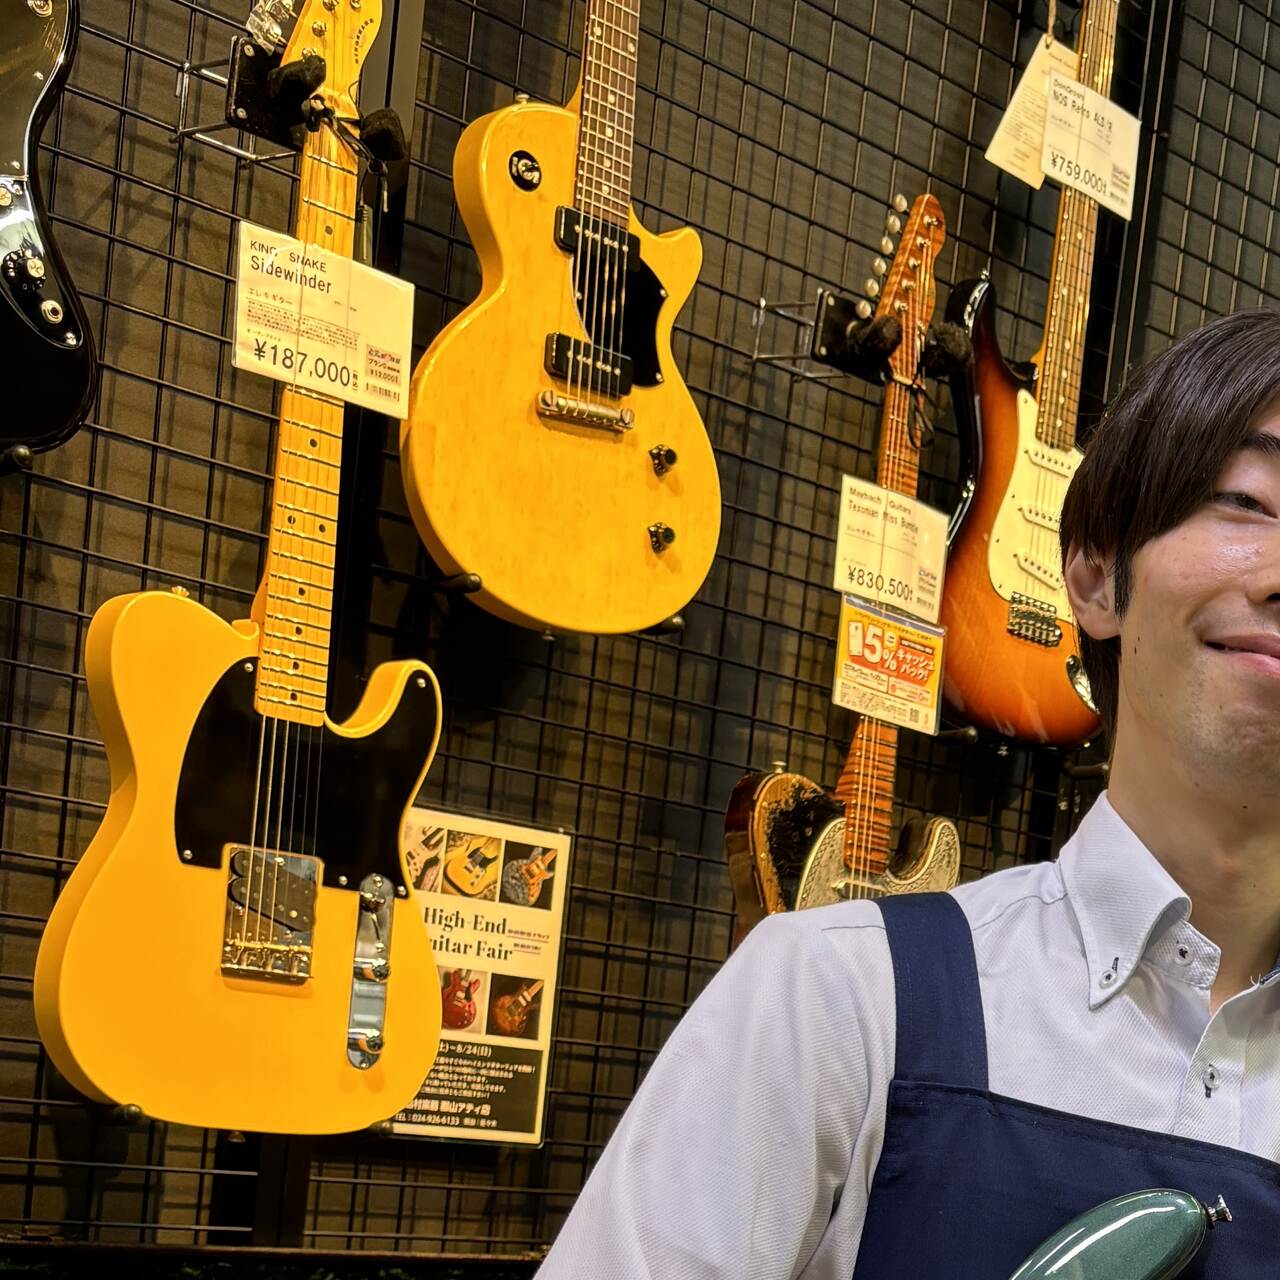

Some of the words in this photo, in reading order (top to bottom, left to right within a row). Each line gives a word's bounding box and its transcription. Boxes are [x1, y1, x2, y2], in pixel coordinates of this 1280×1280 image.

[251, 256, 332, 294] Sidewinder
[289, 252, 327, 273] SNAKE
[254, 338, 351, 387] ¥187,000
[429, 937, 472, 956] uitar
[476, 940, 514, 962] Fair
